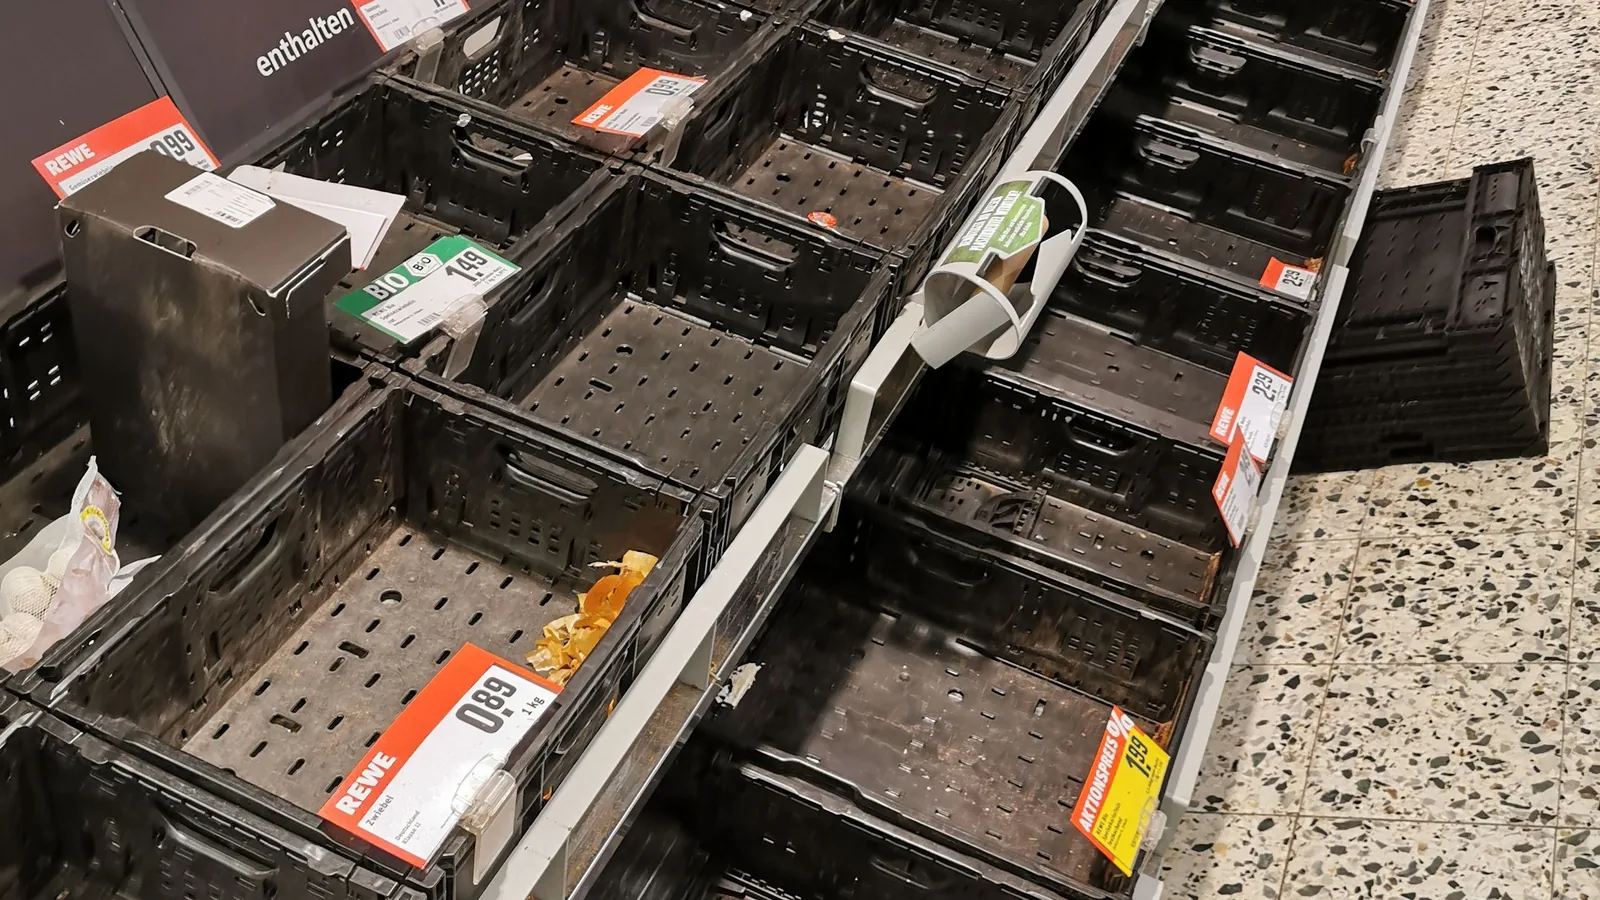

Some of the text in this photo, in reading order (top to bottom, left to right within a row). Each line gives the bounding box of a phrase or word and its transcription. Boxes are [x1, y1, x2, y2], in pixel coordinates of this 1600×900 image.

[256, 6, 355, 77] enthalten
[581, 104, 614, 124] REWE
[43, 142, 96, 177] REWE
[445, 250, 488, 282] 1.49
[1282, 269, 1304, 288] 2.29
[362, 272, 410, 300] BIO
[1252, 371, 1278, 403] 2.29
[1215, 406, 1235, 437] REWE
[455, 676, 517, 735] 0.89
[521, 696, 546, 717] 1 kg
[1125, 735, 1151, 779] 1.99
[335, 751, 398, 817] REWE
[1078, 737, 1119, 833] AKTIONSPREIS
[365, 794, 395, 827] Zwiebel
[394, 810, 421, 842] Deutschland
[402, 825, 417, 845] Klasse
